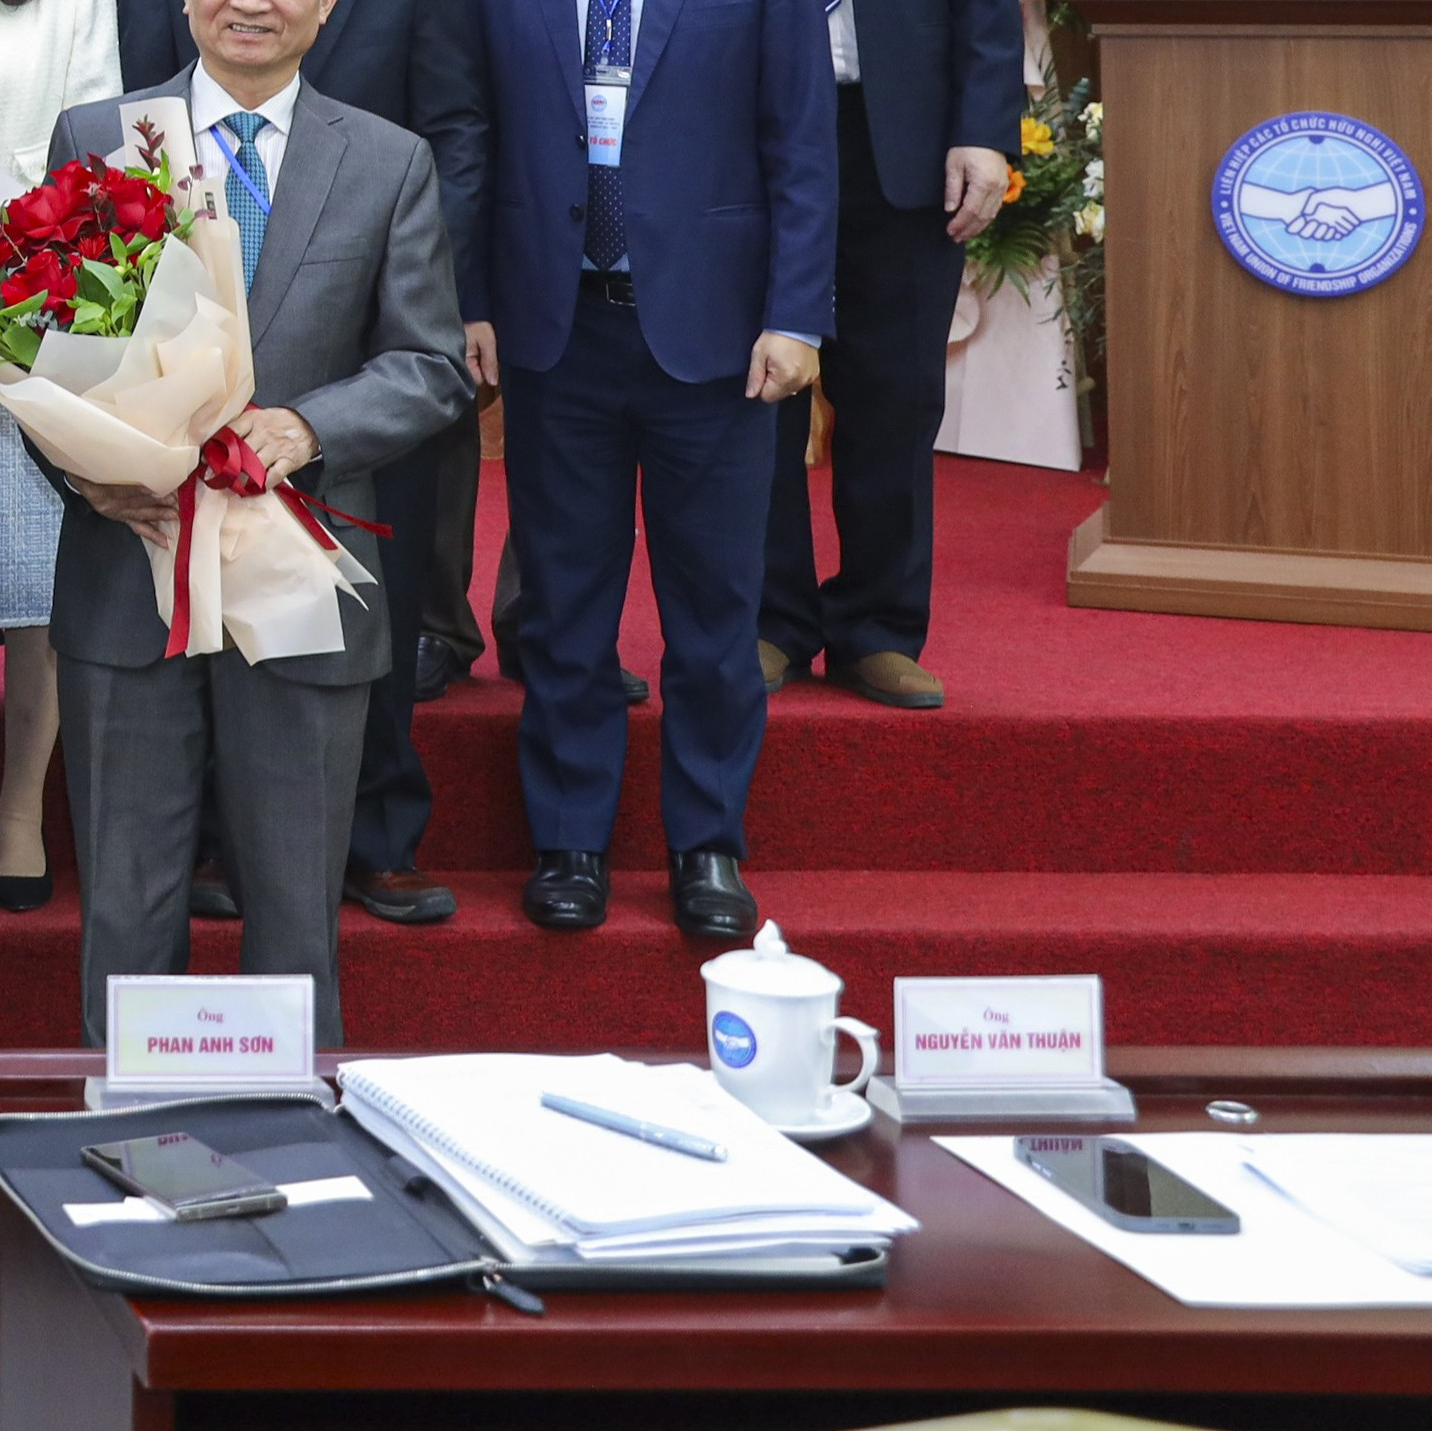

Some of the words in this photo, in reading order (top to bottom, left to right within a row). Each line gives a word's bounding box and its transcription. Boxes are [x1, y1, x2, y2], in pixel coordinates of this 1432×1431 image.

[1245, 253, 1278, 279] UNION
[1292, 276, 1357, 291] FRIENDSHIP
[1357, 221, 1417, 284] ORGANIZATIONS
[197, 1006, 224, 1024] Ông
[983, 1007, 1010, 1023] Ông
[147, 1036, 194, 1054] PHAN
[198, 1036, 234, 1054] ANH
[239, 1035, 274, 1054] SƠN
[915, 1026, 983, 1050] NGUYỄN
[987, 1029, 1022, 1049] VĂN
[1027, 1027, 1081, 1052] THUẬN
